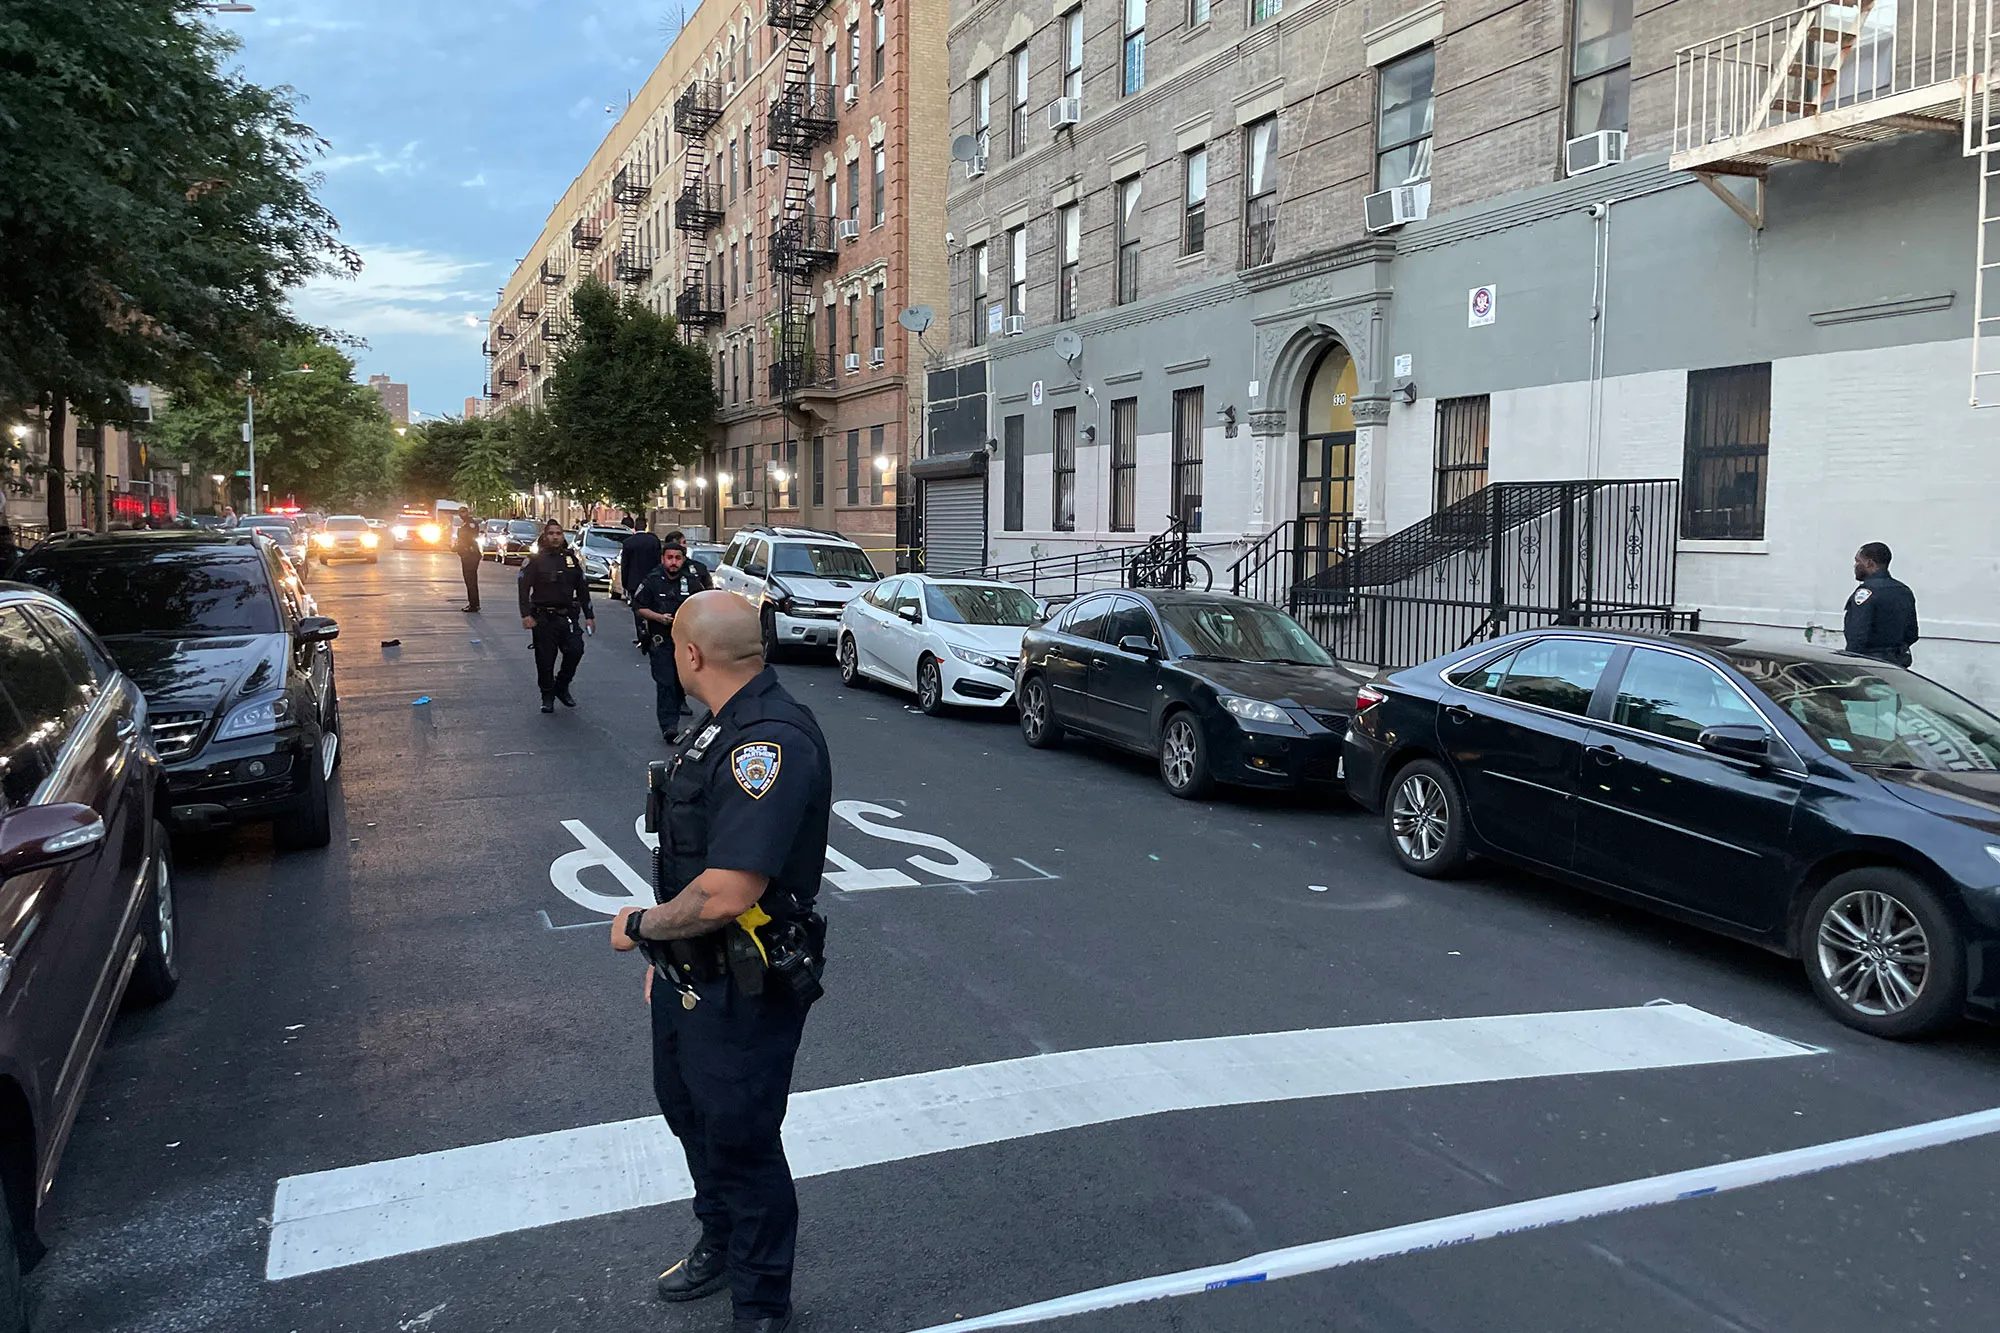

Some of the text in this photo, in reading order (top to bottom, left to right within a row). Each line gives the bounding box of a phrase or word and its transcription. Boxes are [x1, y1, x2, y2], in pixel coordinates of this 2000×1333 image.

[1333, 393, 1346, 406] 320
[736, 752, 776, 763] DEPARTMENT
[736, 768, 752, 789] CITY OF
[760, 761, 779, 790] NEW YORK
[549, 800, 994, 916] STP
